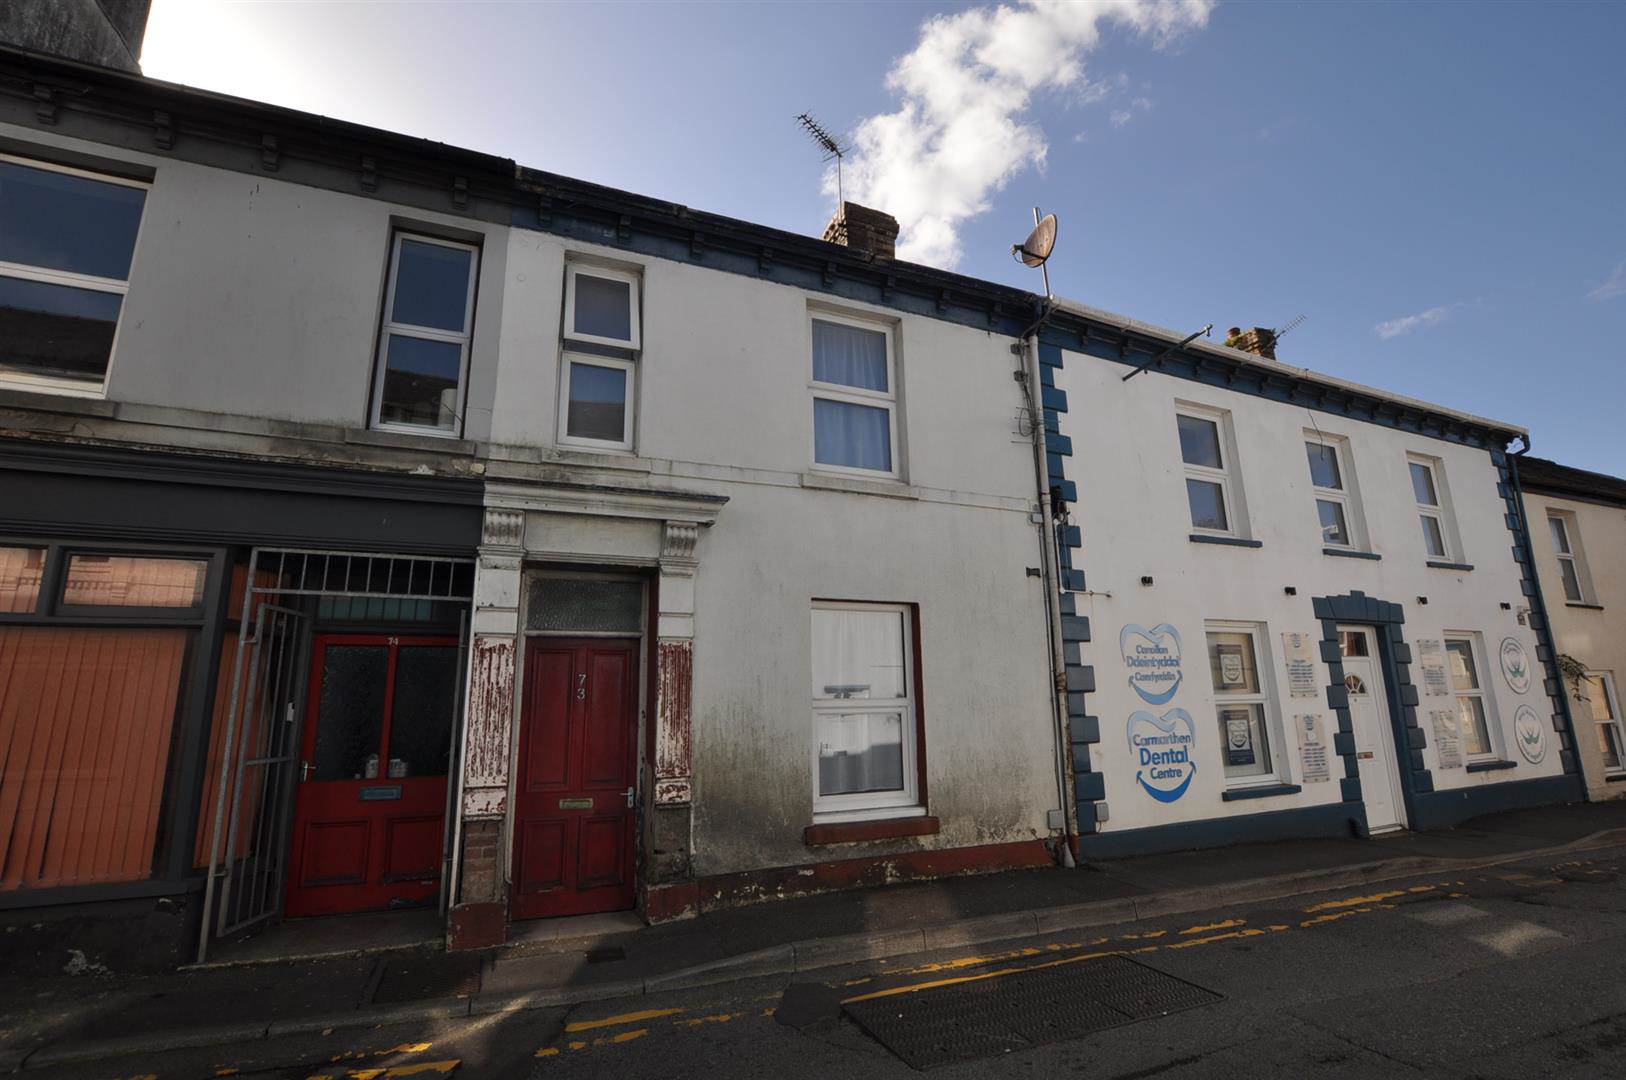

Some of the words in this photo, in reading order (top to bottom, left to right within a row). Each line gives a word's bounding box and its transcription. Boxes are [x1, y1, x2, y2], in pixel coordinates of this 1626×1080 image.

[1133, 732, 1191, 746] Carmarthen
[1139, 745, 1188, 766] Dental
[1151, 767, 1182, 779] Centre
